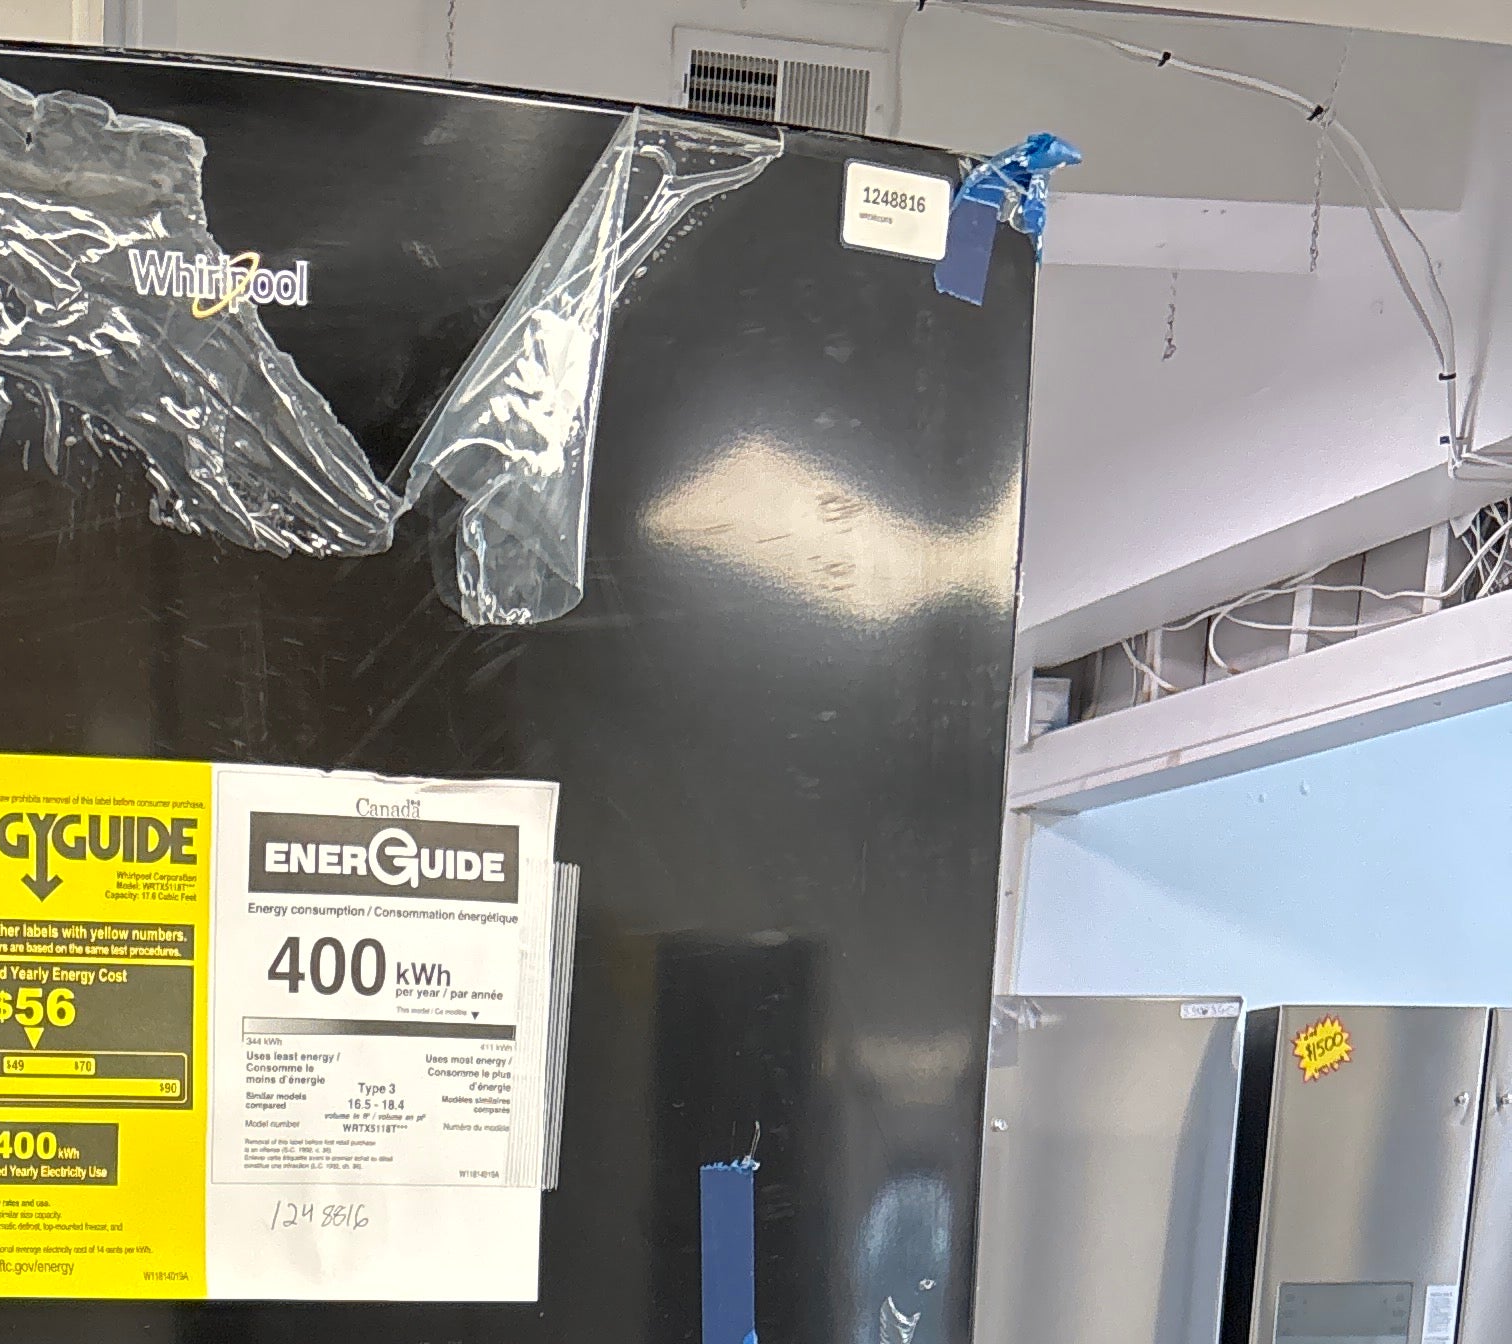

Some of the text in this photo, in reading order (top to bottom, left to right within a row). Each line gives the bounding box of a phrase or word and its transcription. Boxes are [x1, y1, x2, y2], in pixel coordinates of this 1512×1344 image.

[862, 185, 926, 213] 1248816
[128, 249, 311, 314] Whirlpool
[355, 798, 422, 819] Canada
[265, 827, 506, 888] ENERGUIDE
[247, 902, 518, 926] Energy consumption / Consommation énergétique
[22, 923, 58, 938] labels
[61, 924, 87, 939] with
[90, 925, 128, 942] yellow
[131, 926, 187, 941] numbers.
[9, 943, 24, 952] are
[25, 942, 53, 953] based
[54, 944, 67, 953] on
[68, 943, 83, 954] the
[84, 945, 109, 955] same
[110, 944, 127, 955] test
[129, 945, 181, 959] procedures.
[267, 936, 451, 996] 400 kWh
[10, 965, 49, 984] Yearly
[52, 966, 95, 984] Energy
[98, 967, 127, 982] Cost
[395, 988, 503, 1000] per year / par année
[246, 1051, 340, 1063] Uses least energy /
[425, 1054, 448, 1064] Uses
[450, 1055, 473, 1064] most
[475, 1057, 506, 1067] energy
[6, 1059, 25, 1073] $49
[245, 1062, 314, 1072] Consomme le
[427, 1066, 511, 1080] Consomme le plus
[159, 1082, 177, 1096] $90
[359, 1082, 395, 1096] Type 3
[348, 1099, 371, 1109] 16.5
[383, 1099, 404, 1110] 18.4
[58, 1147, 80, 1160] kWh
[9, 1164, 38, 1179] Yearly
[40, 1165, 86, 1180] Electricity
[88, 1165, 107, 1177] Use
